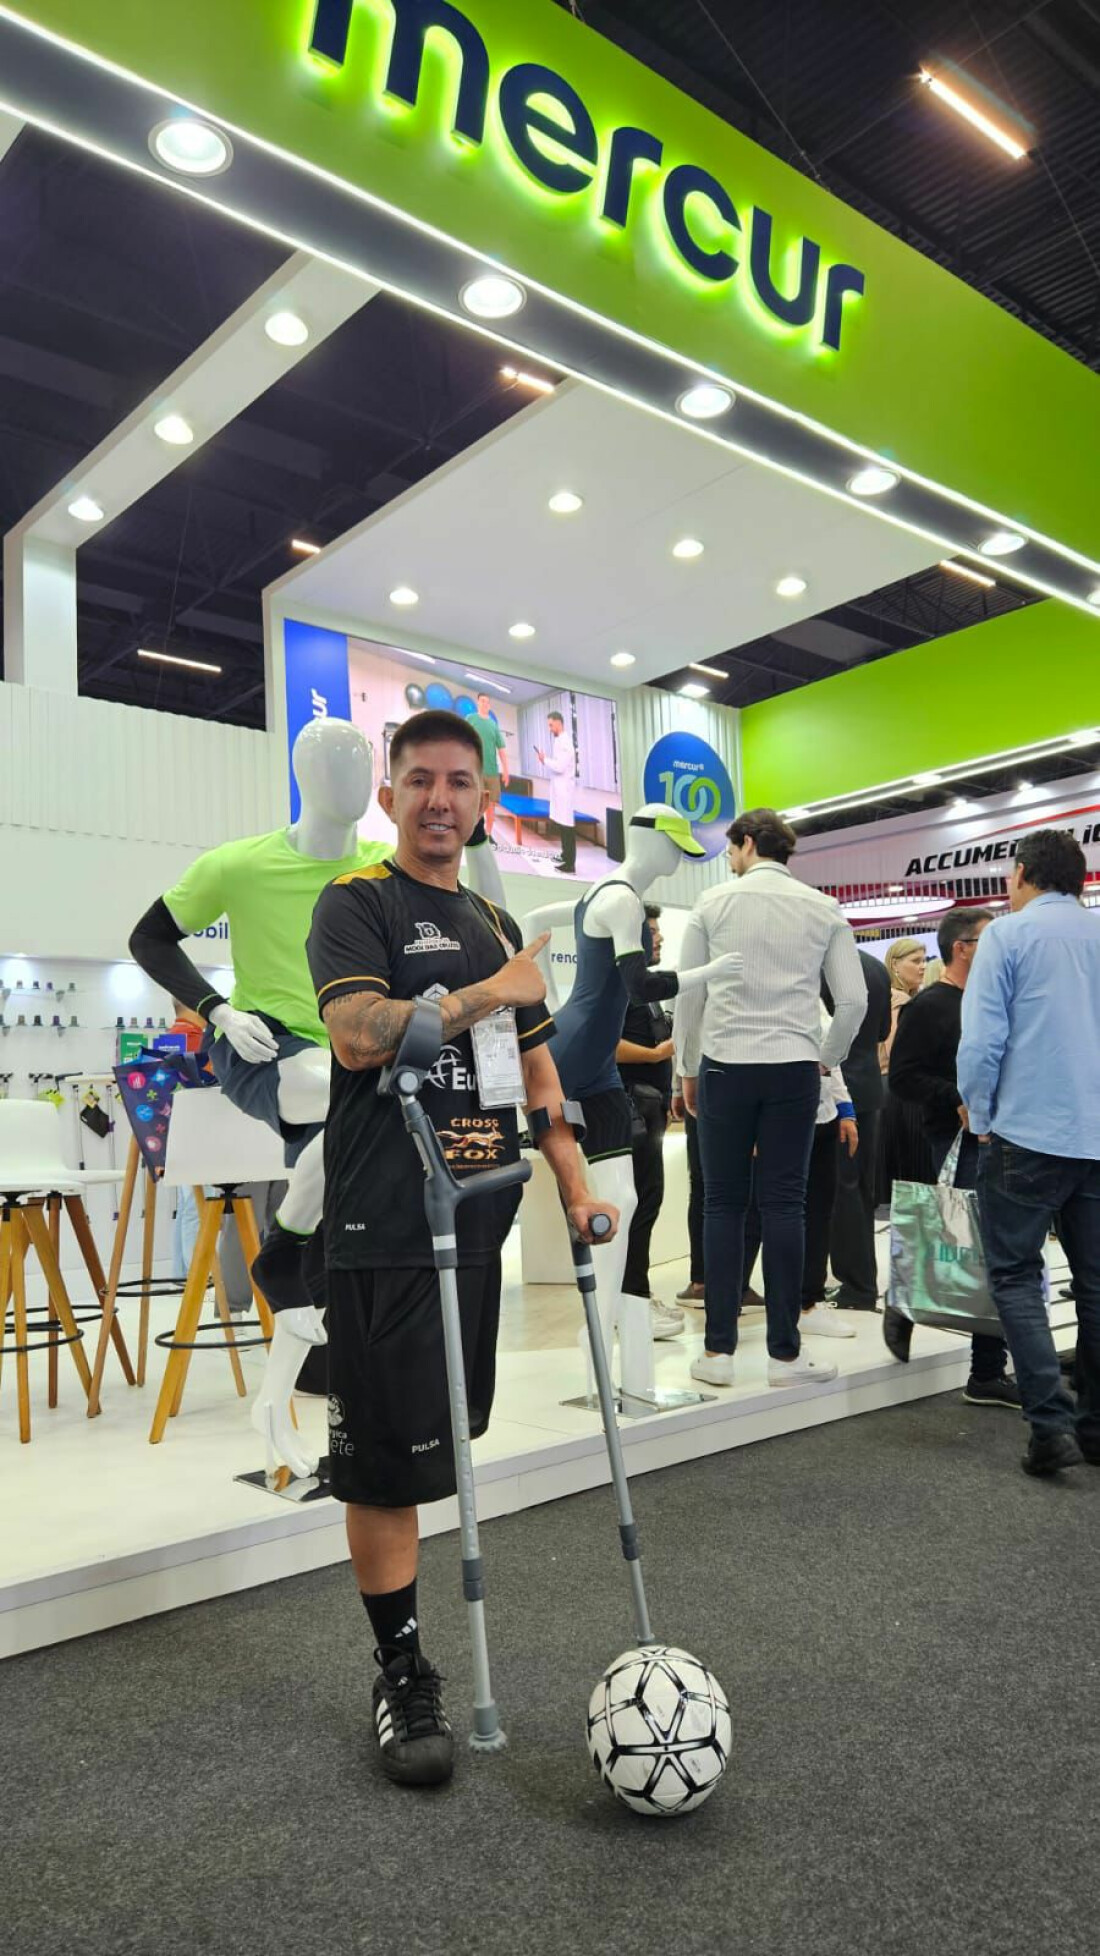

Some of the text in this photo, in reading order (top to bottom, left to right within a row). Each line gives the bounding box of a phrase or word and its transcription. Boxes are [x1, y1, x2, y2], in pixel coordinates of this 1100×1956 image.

[308, 0, 865, 351] mercur
[659, 771, 721, 823] 100
[451, 1118, 501, 1128] CROSS
[445, 1149, 498, 1160] FOX
[411, 1438, 440, 1454] PULSA
